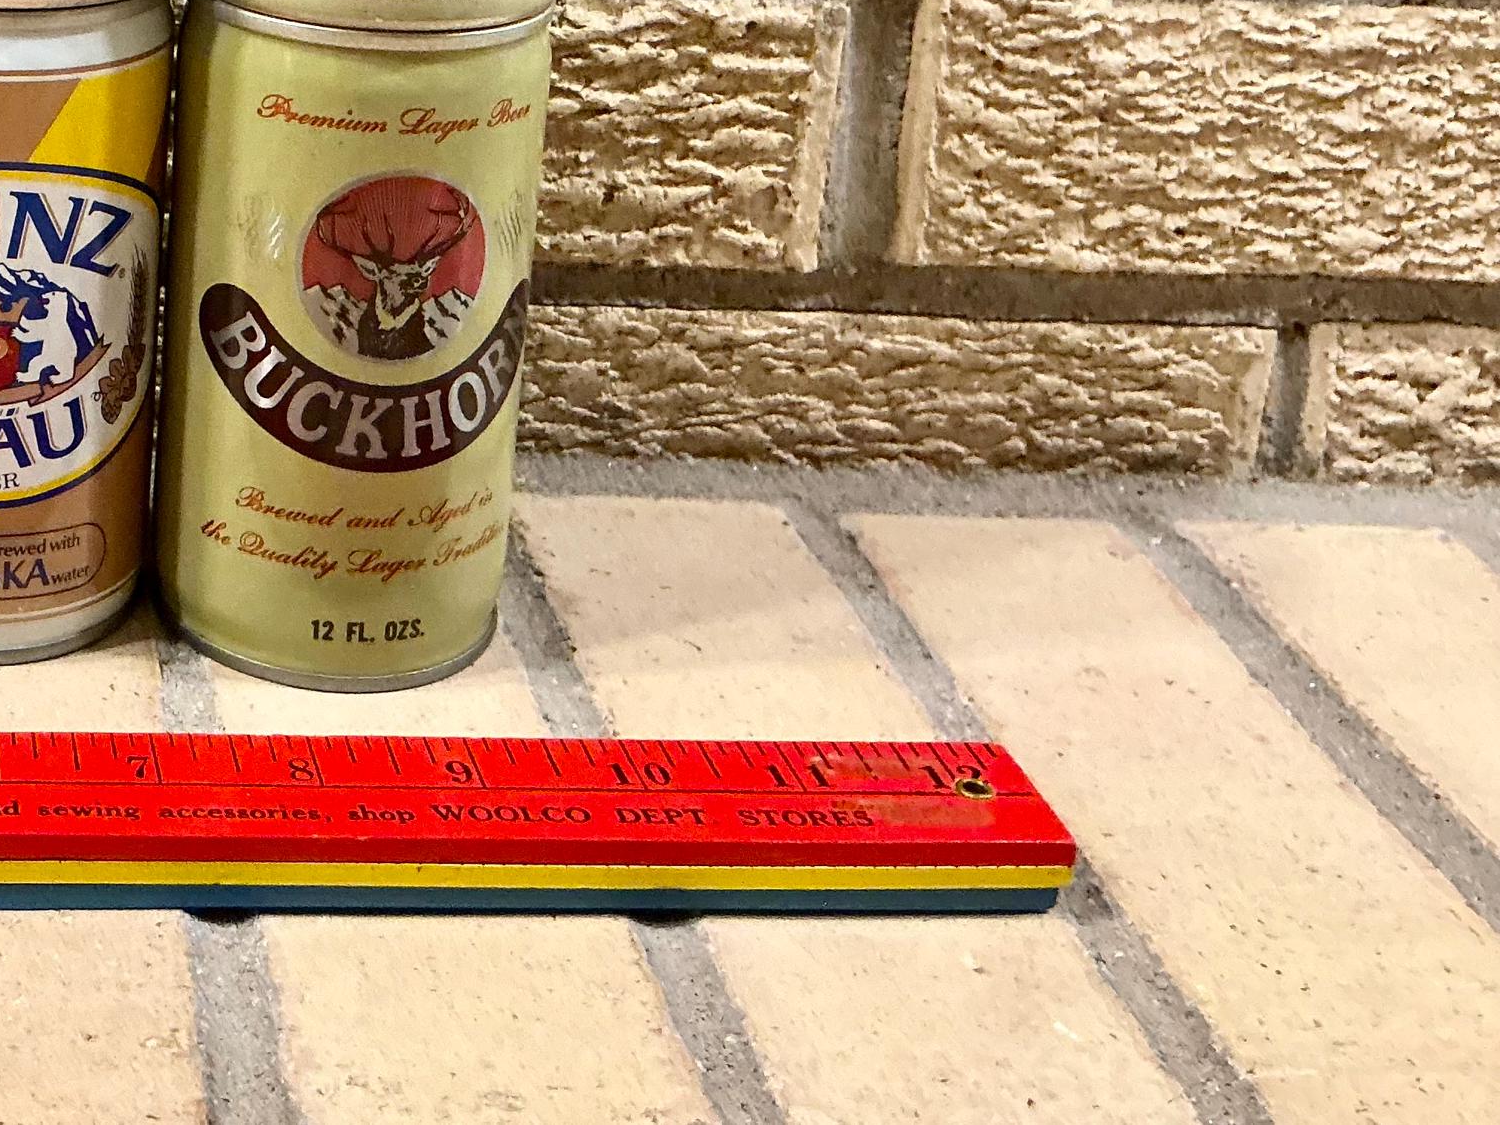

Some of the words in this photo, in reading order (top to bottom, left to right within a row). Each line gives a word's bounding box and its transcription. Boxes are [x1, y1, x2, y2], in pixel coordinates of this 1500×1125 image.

[257, 94, 388, 134] Premium
[399, 107, 479, 145] Lager
[486, 98, 531, 129] Beer
[235, 486, 344, 528] Brewed
[346, 507, 405, 529] and
[407, 491, 478, 533] Aged
[49, 533, 81, 552] with
[200, 518, 233, 546] the
[237, 530, 338, 580] Quality
[346, 548, 427, 583] Lager
[311, 618, 335, 641] 12
[346, 621, 376, 643] FL.
[384, 618, 426, 642] OZS.
[126, 755, 150, 778] 7
[289, 757, 315, 782] 8
[445, 759, 474, 784] 9
[605, 761, 672, 787] 10
[765, 763, 834, 789] 11
[37, 801, 140, 820] sewing
[159, 803, 332, 823] accessories,
[347, 803, 416, 823] shop
[431, 804, 592, 825] WOOLCO
[740, 808, 874, 828] STORES
